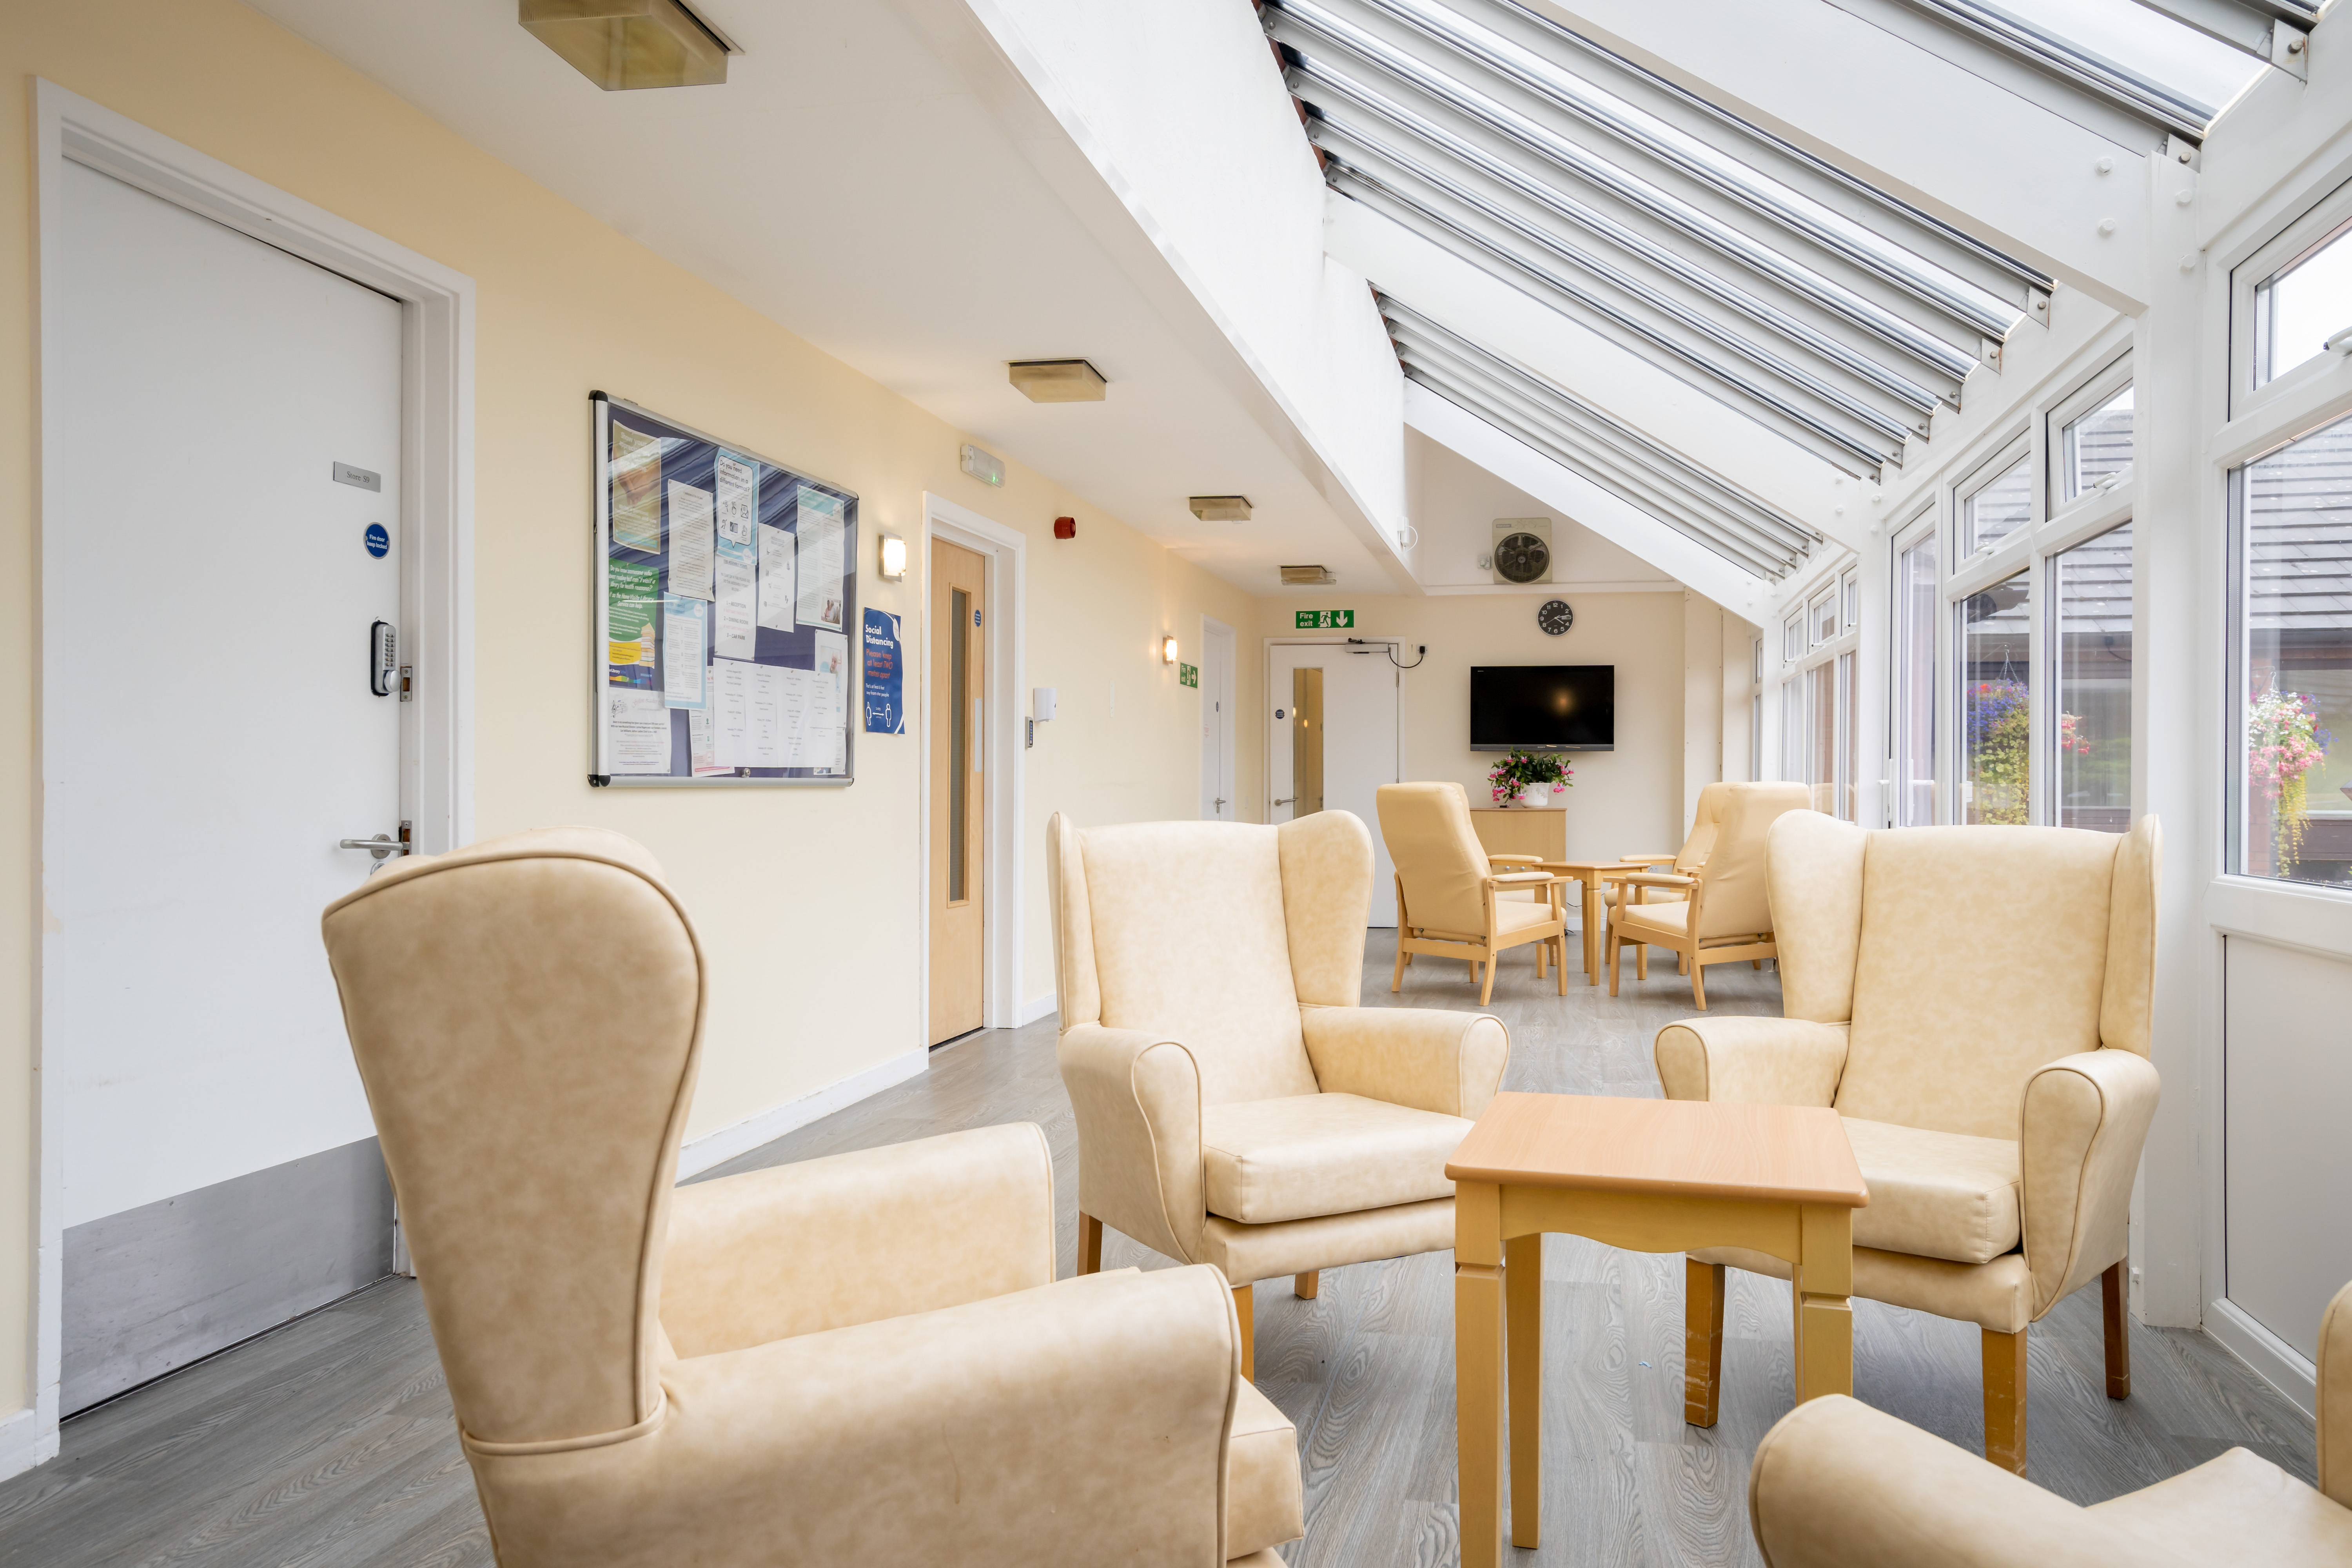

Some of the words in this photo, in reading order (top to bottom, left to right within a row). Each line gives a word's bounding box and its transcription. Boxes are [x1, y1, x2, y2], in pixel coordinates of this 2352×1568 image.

[621, 432, 633, 443] Show
[347, 471, 361, 481] Store
[720, 468, 740, 480] information
[719, 477, 734, 486] different
[735, 482, 750, 492] format?
[866, 624, 882, 635] Social
[866, 635, 893, 649] Distancing
[866, 648, 881, 658] Please
[882, 650, 891, 661] keep
[873, 659, 882, 667] least
[883, 661, 893, 669] TWO
